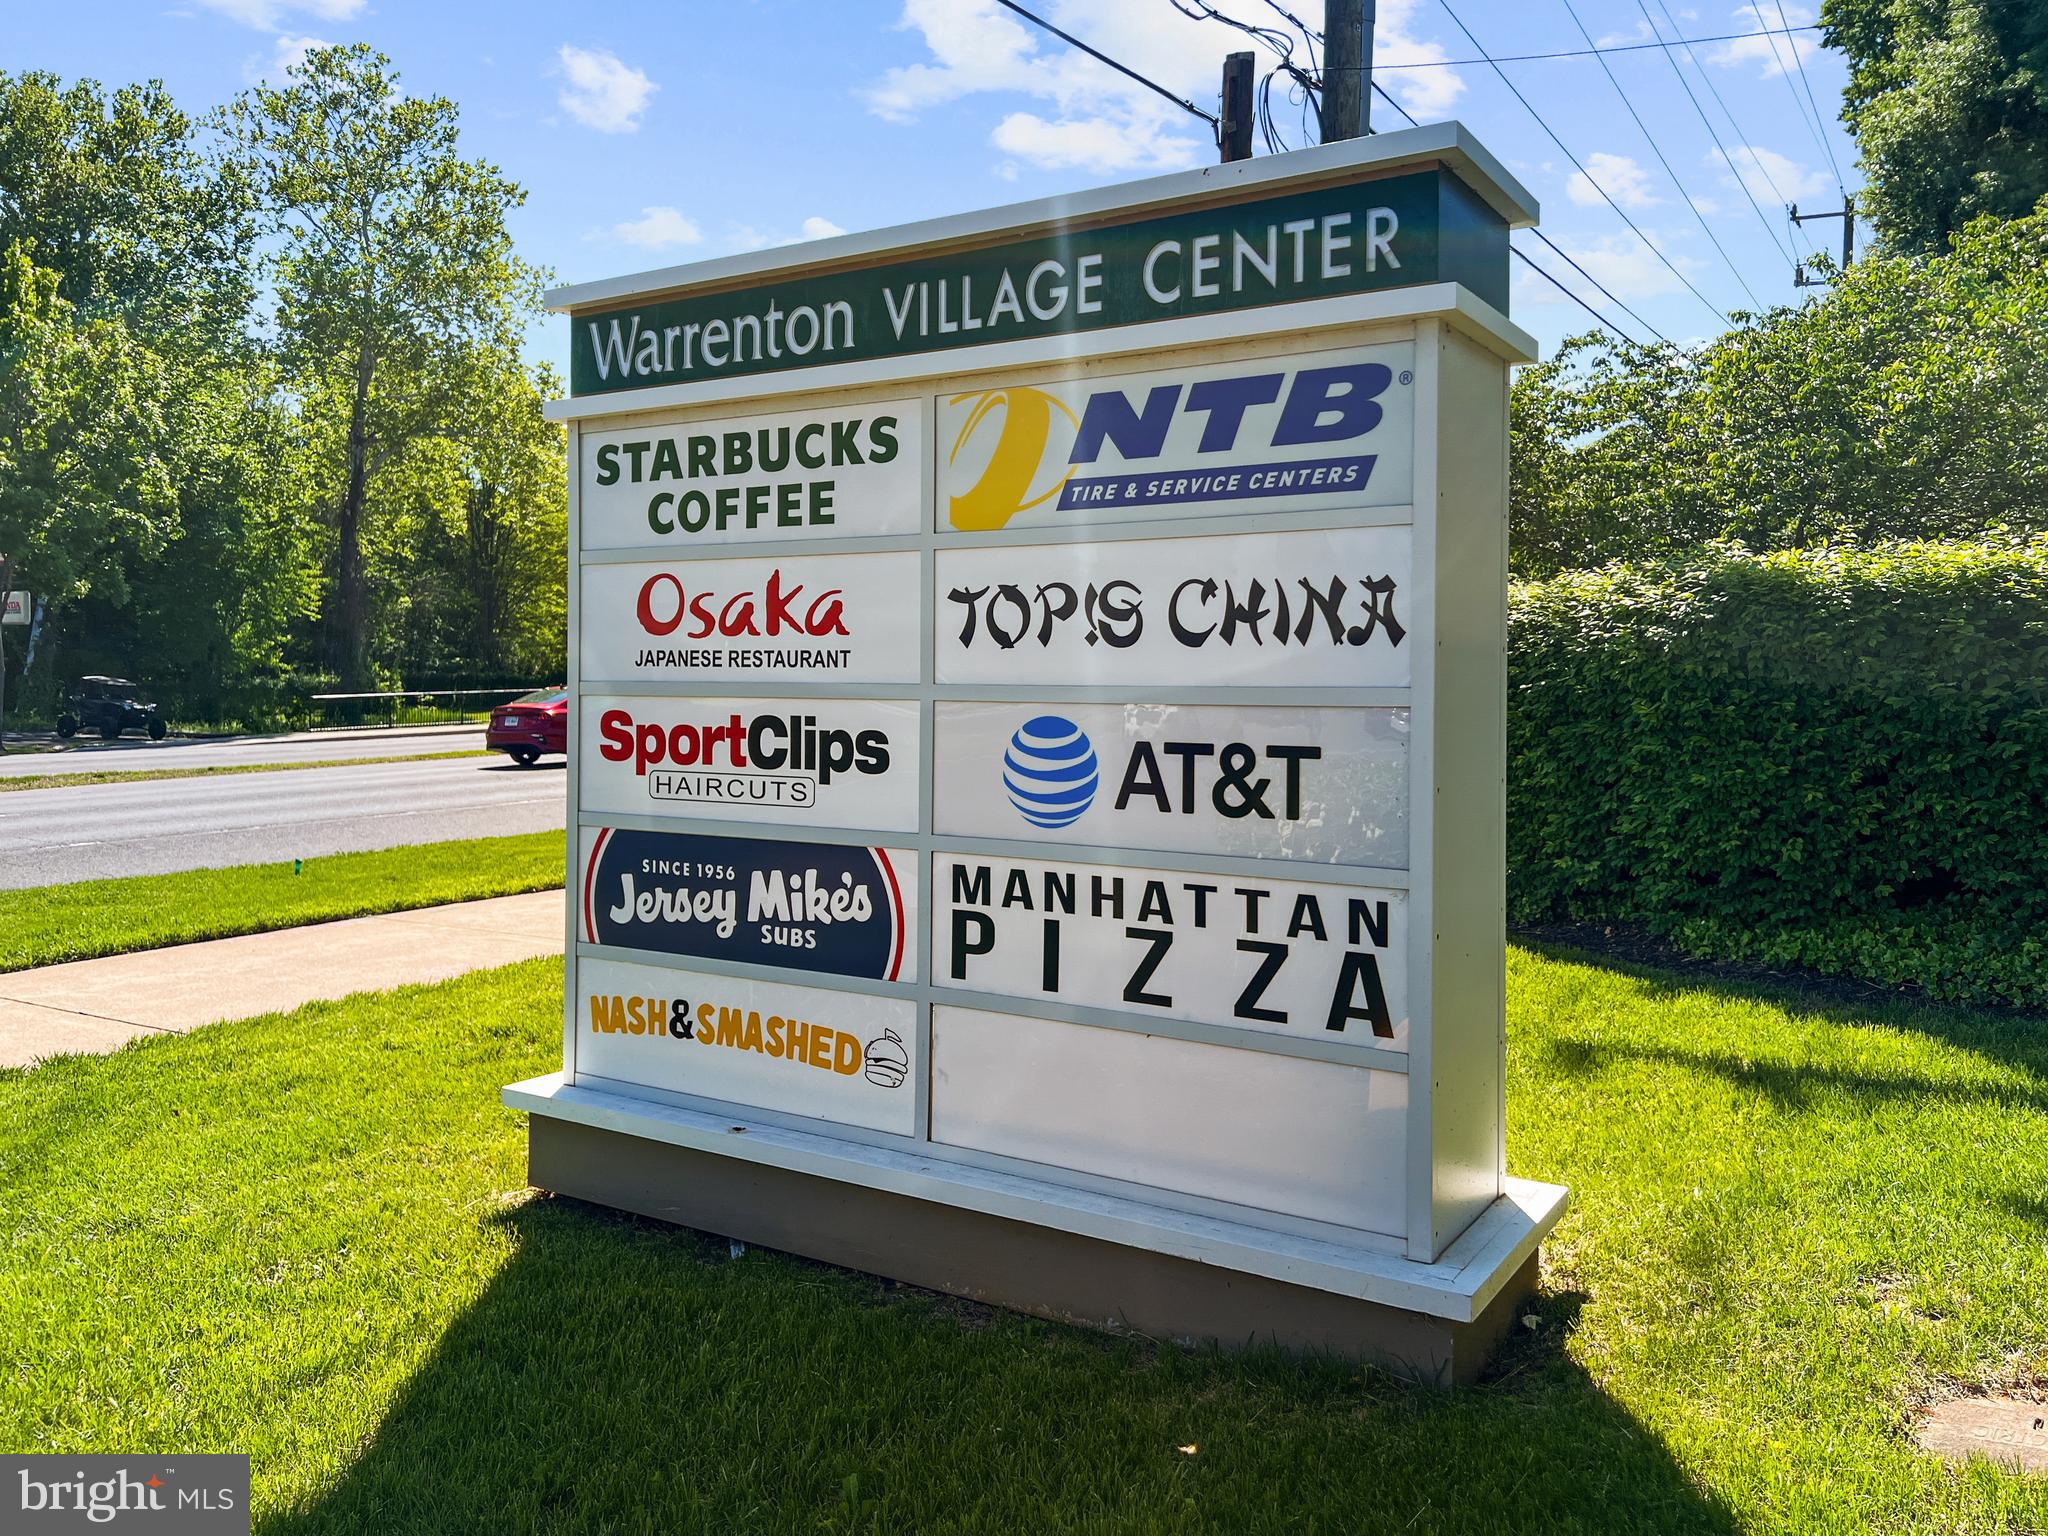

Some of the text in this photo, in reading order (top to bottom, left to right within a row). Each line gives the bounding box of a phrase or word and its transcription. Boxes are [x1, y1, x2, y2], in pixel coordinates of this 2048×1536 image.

[587, 206, 1402, 381] Warrenton VILLAGE CENTER
[1067, 362, 1393, 465] NTB
[595, 416, 899, 486] STARBUCKS
[1071, 465, 1360, 502] TIRE & SERVICE CENTERS
[647, 480, 836, 535] COFFEE
[636, 568, 851, 639] Osaka
[1168, 573, 1407, 649] CHINA
[634, 649, 851, 668] JAPANESE RESTAURANT
[599, 709, 890, 785] SportClips
[1113, 740, 1322, 821] AT&T
[655, 775, 808, 802] HAIRCUTS
[608, 868, 873, 939] Jersey Mike's
[641, 858, 736, 881] SINCE 1956
[760, 924, 817, 950] SUBS
[951, 863, 1389, 949] MANHATTAN
[950, 909, 1395, 1040] PIZZA
[589, 994, 863, 1077] NASH&SMASHED
